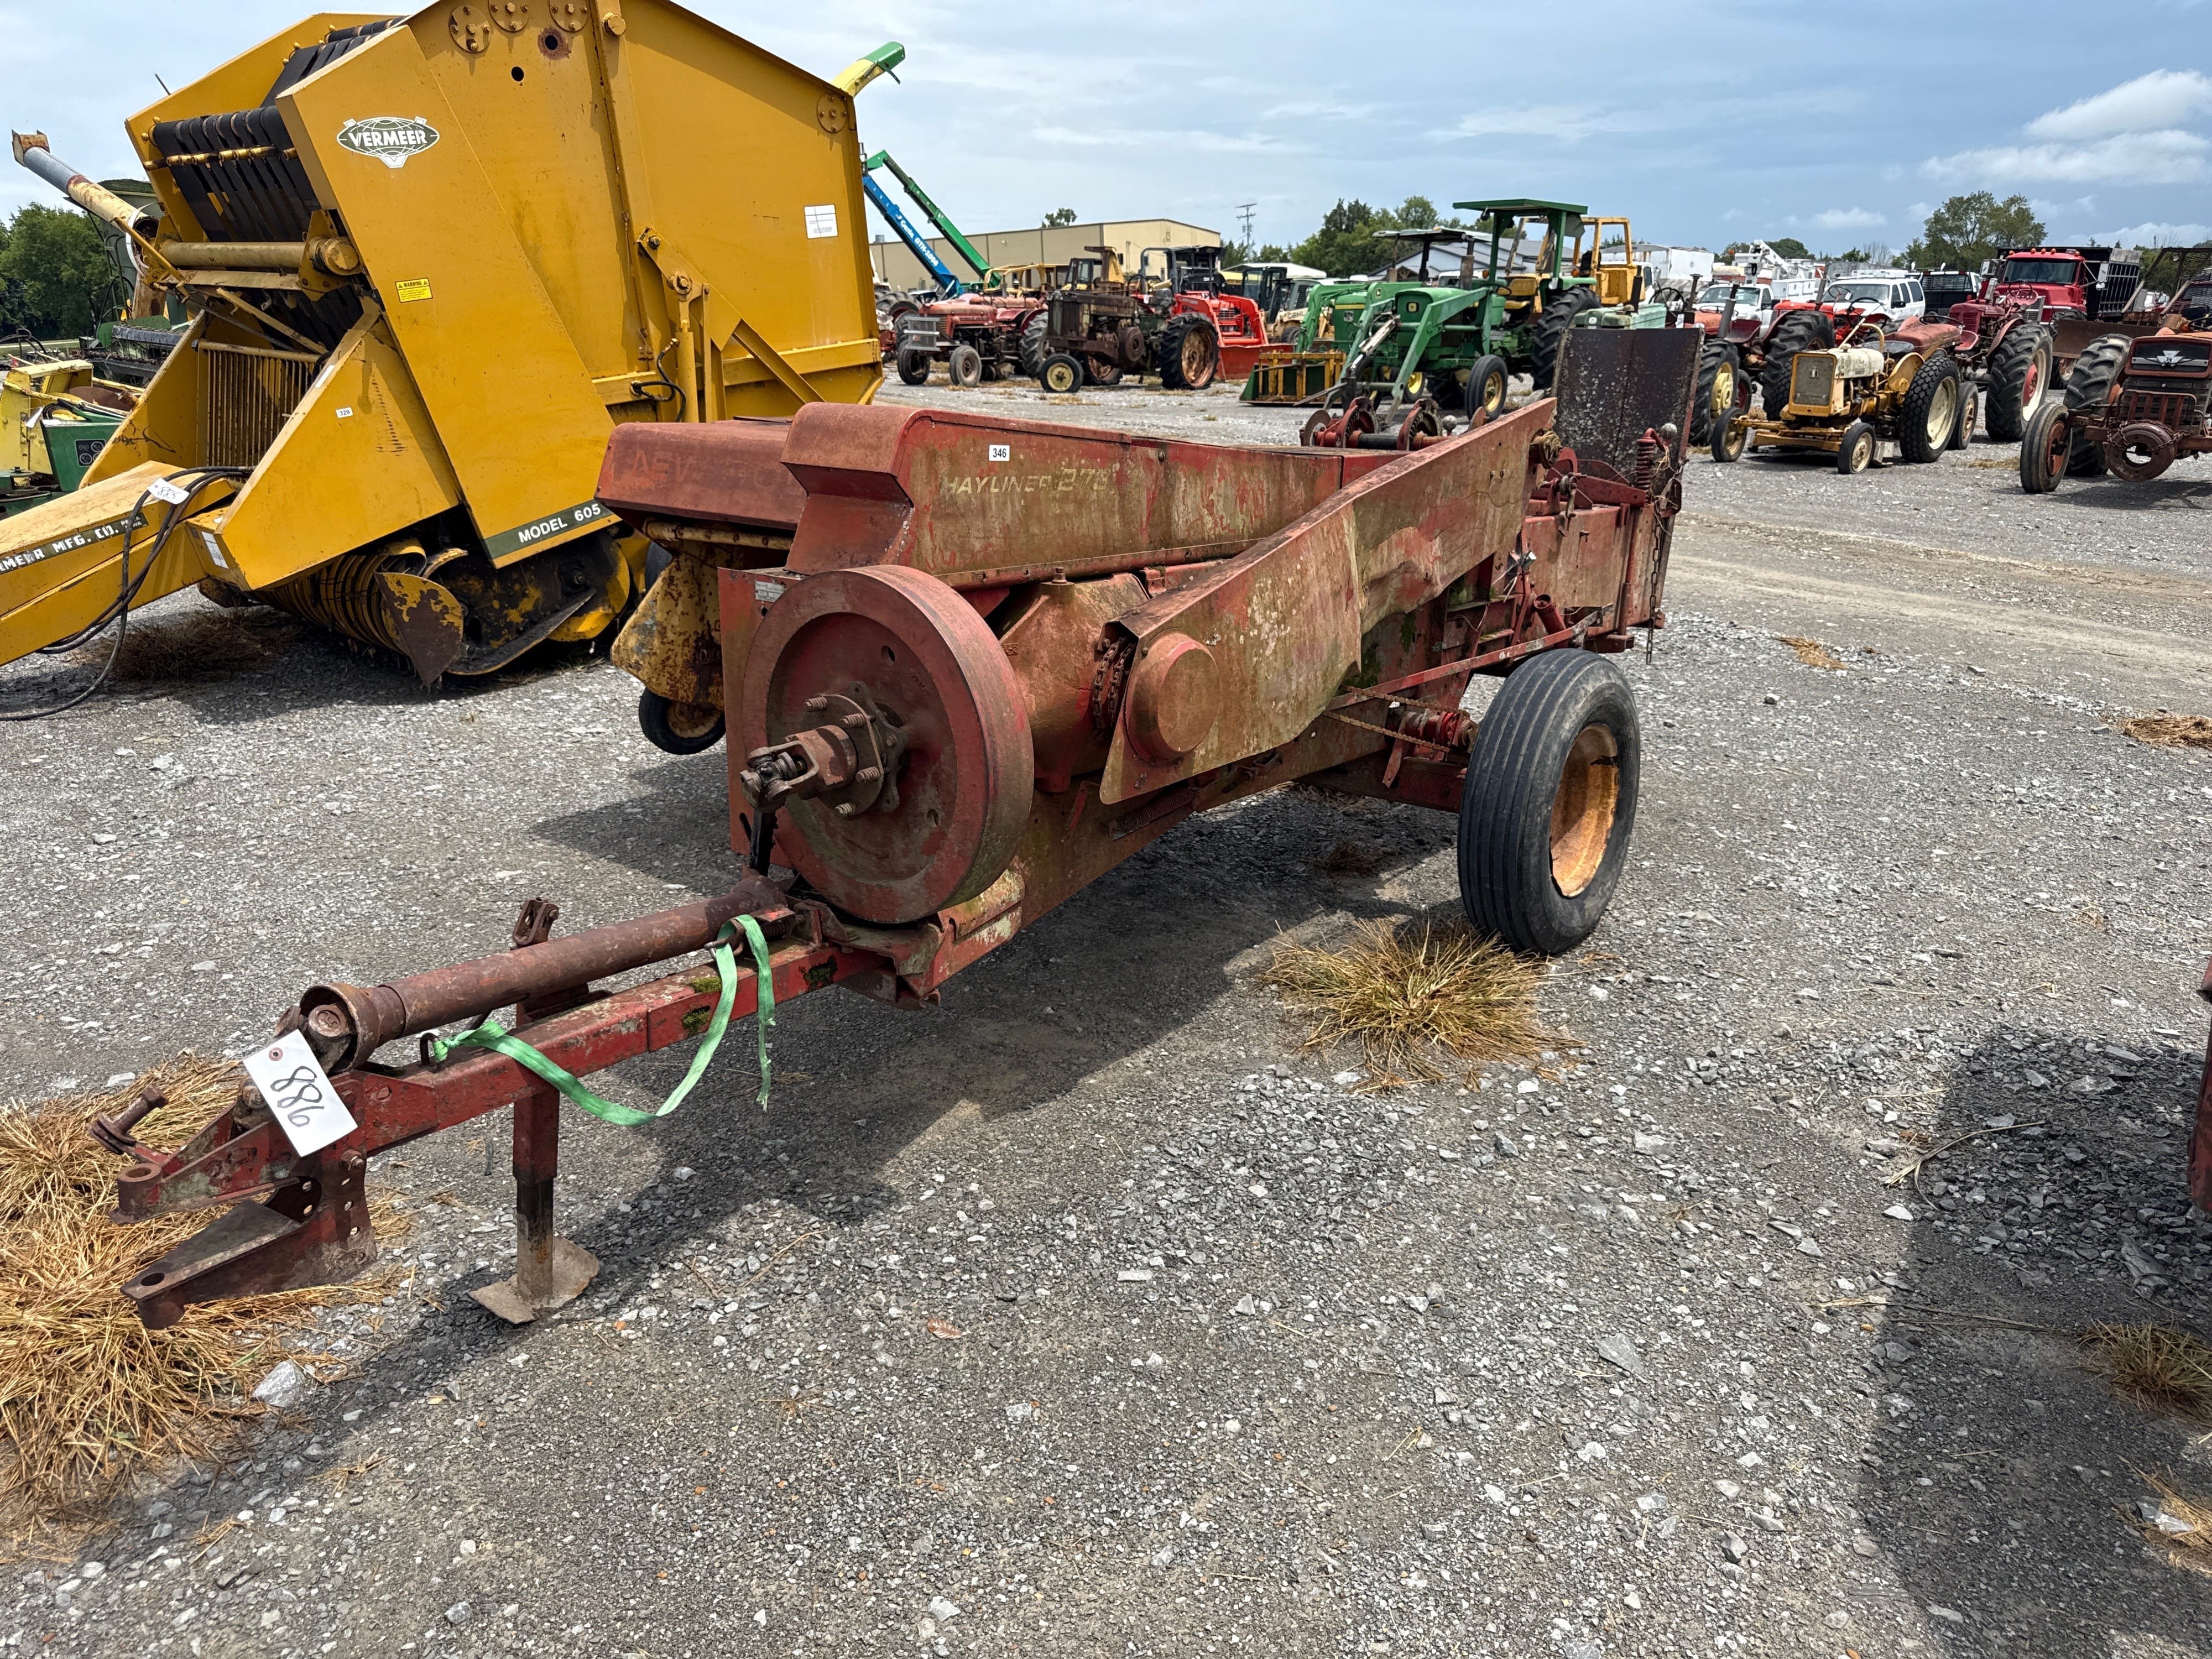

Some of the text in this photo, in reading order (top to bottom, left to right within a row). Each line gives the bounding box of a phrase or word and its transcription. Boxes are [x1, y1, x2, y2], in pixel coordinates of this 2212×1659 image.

[348, 130, 427, 147] VERMEER
[993, 447, 1007, 458] 346
[518, 503, 601, 543] MODEL 605
[52, 534, 92, 553] MFG.
[270, 1065, 325, 1128] 886
